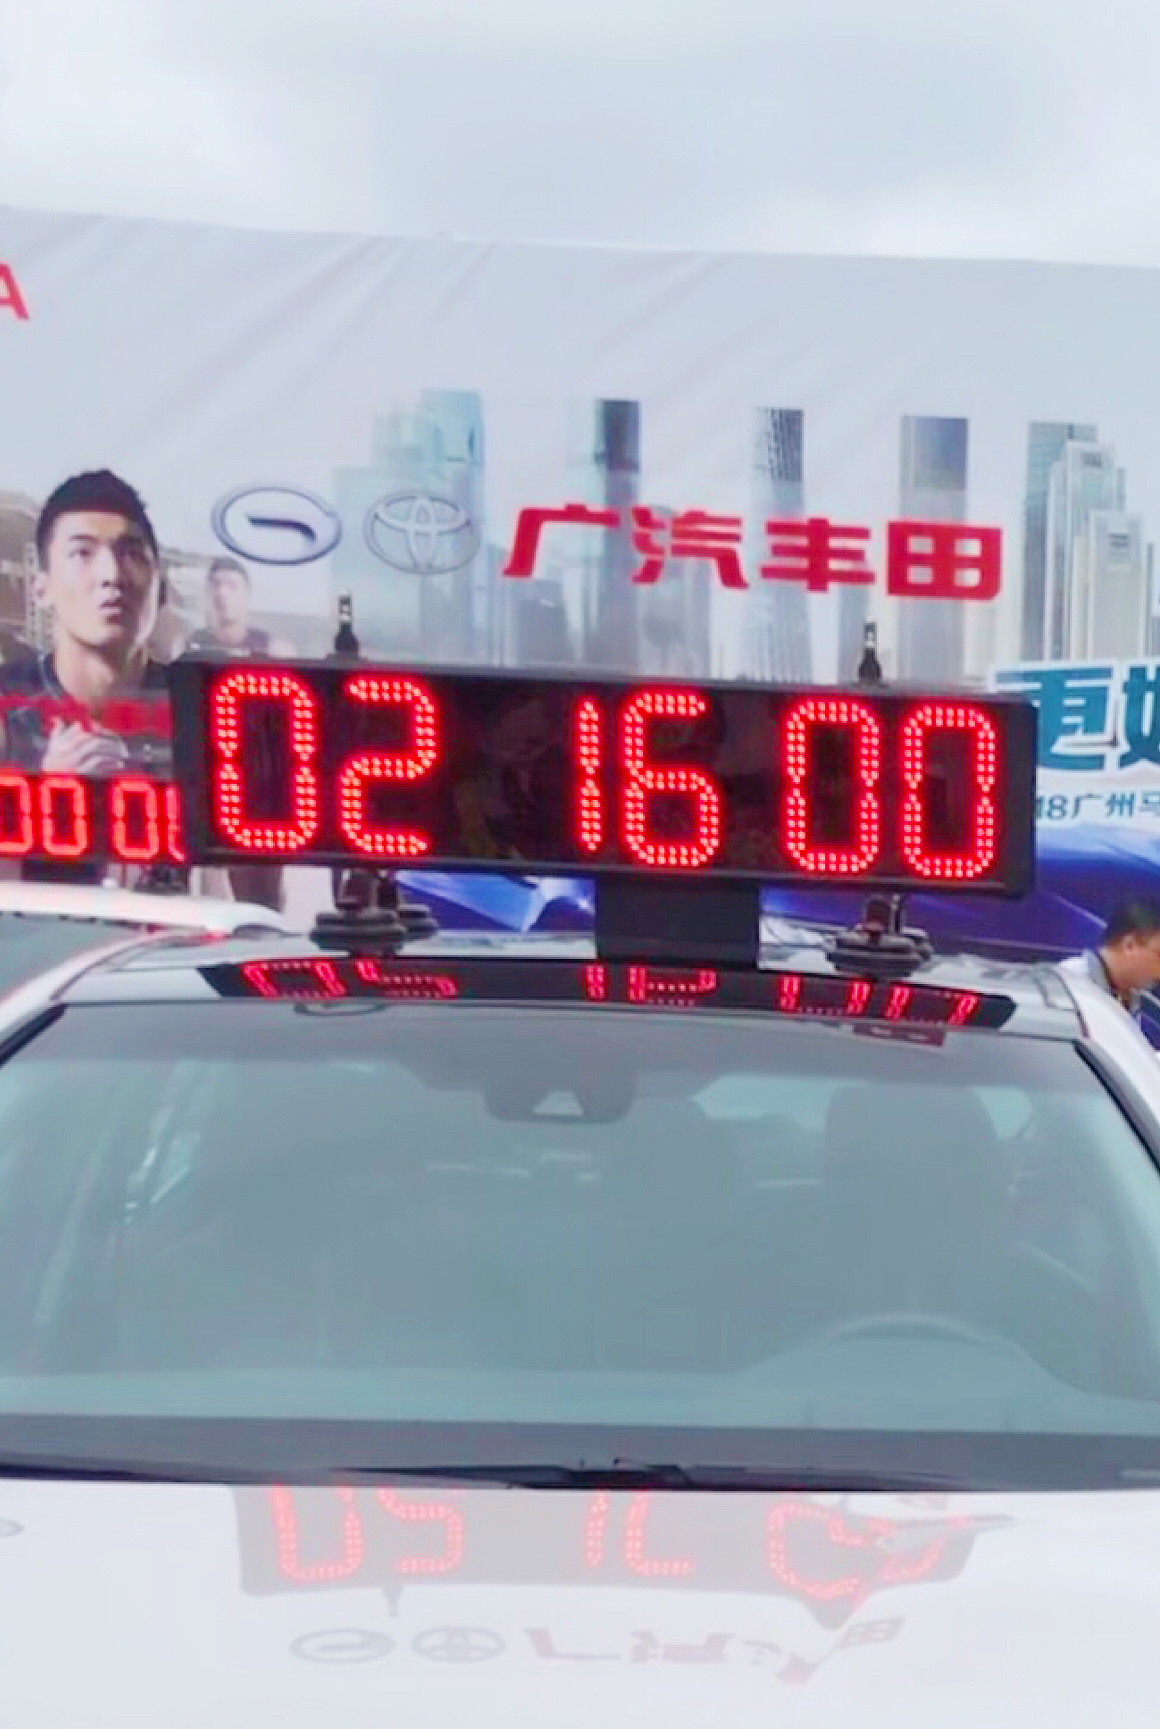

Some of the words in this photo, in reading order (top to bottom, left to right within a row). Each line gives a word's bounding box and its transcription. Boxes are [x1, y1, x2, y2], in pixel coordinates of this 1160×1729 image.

[502, 503, 1003, 601] 广汽丰田
[213, 671, 438, 857] 02
[577, 693, 719, 867] 16
[786, 700, 997, 879] 00
